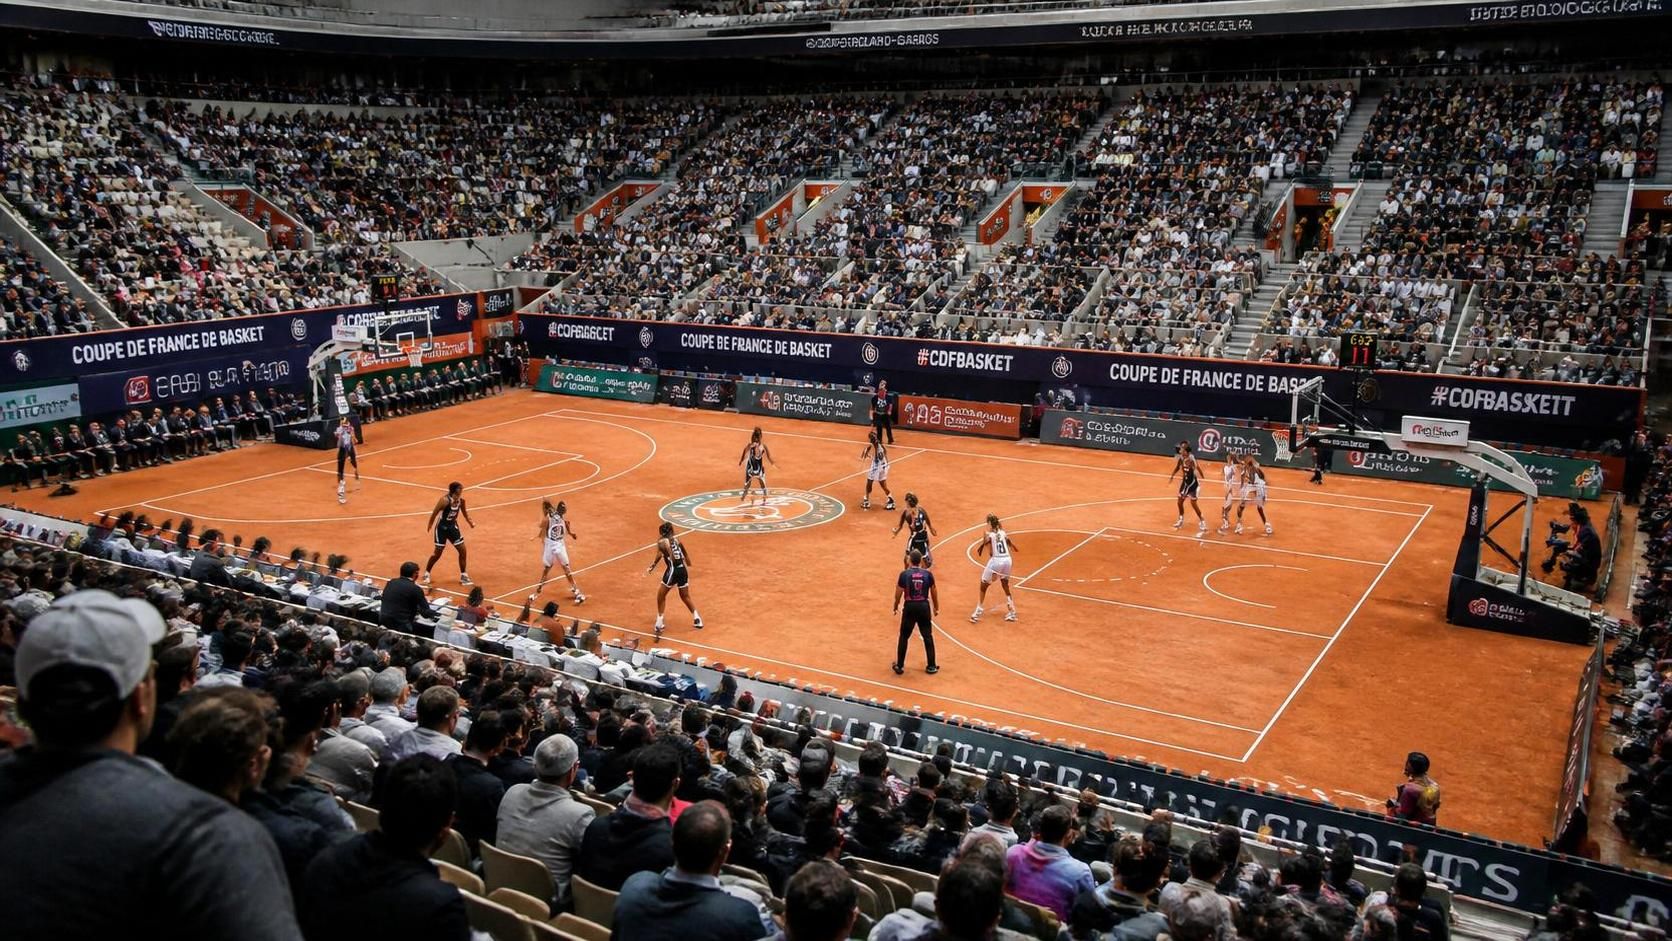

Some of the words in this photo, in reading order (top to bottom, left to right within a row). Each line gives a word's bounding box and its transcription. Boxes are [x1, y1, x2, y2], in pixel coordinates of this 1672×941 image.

[72, 341, 125, 364] COUPE
[127, 338, 147, 358] DE
[149, 333, 200, 354] FRANCE
[220, 326, 265, 345] BASKET
[681, 332, 715, 350] COUPE
[731, 336, 773, 354] FRANCE
[774, 340, 788, 355] DE
[789, 341, 832, 359] BASKET
[1109, 362, 1158, 383] COUPE
[1161, 366, 1180, 385] DE
[1182, 368, 1242, 390] FRANCE
[1245, 373, 1265, 391] DE
